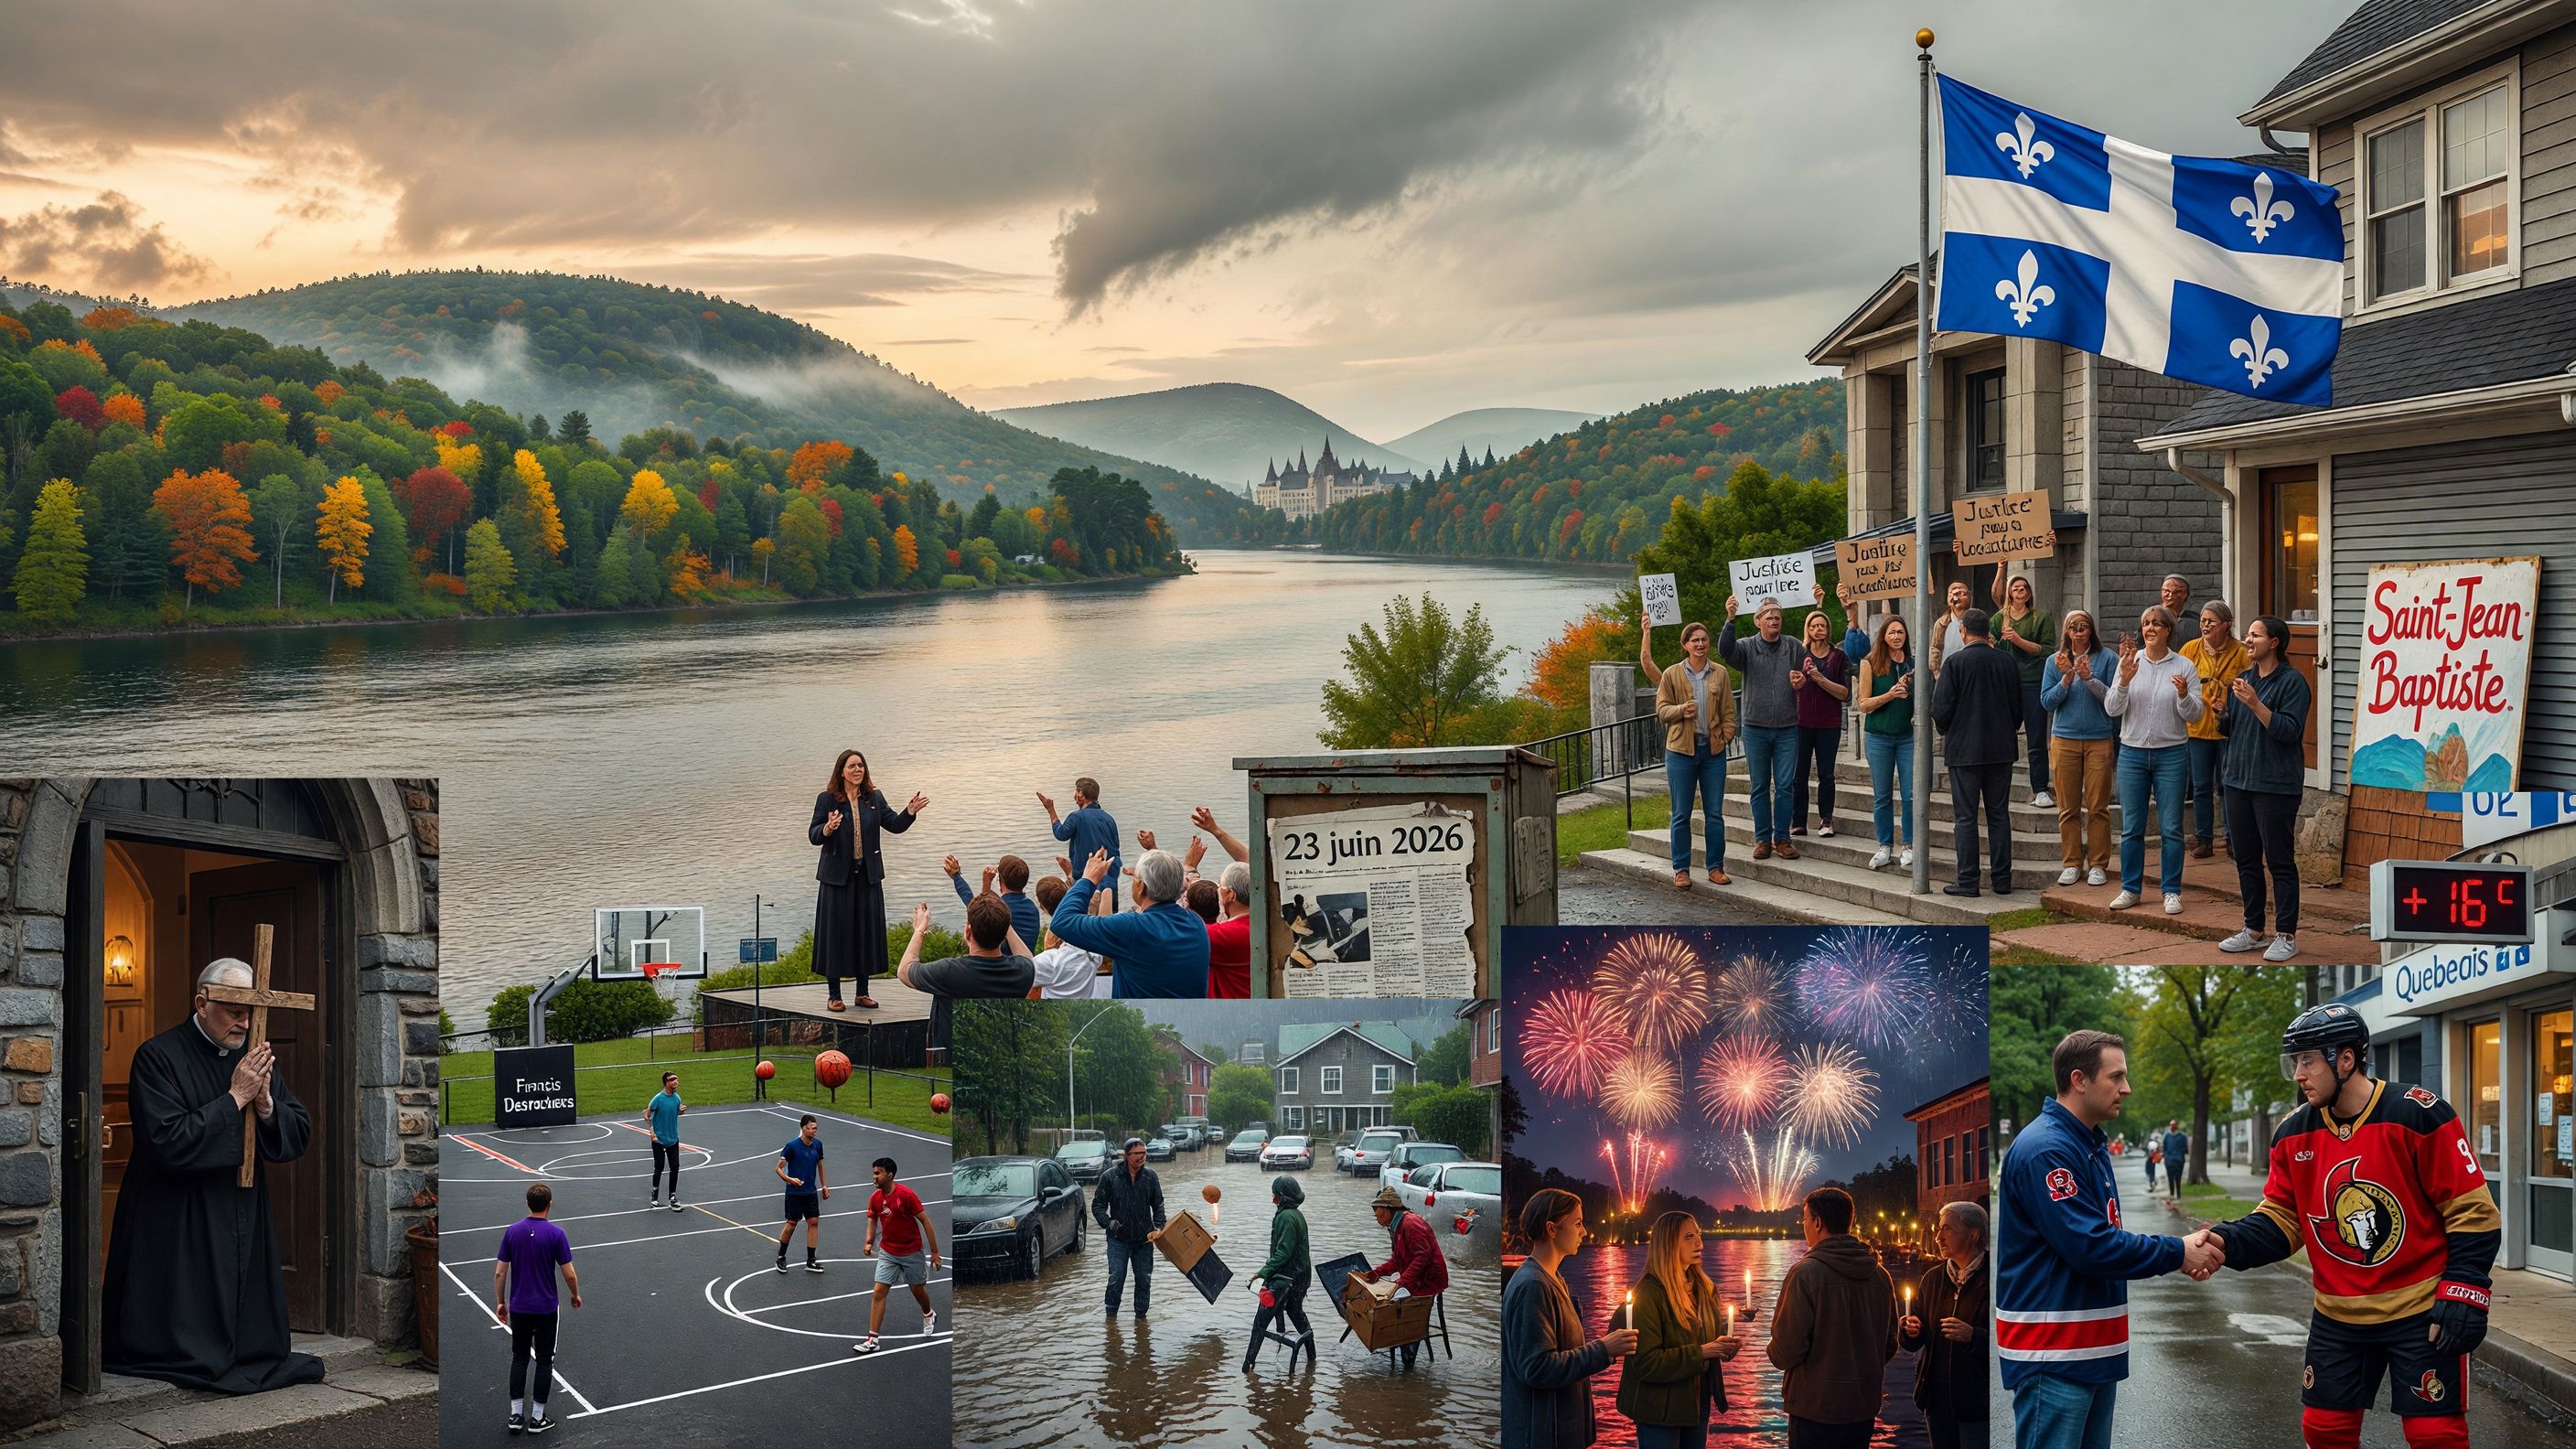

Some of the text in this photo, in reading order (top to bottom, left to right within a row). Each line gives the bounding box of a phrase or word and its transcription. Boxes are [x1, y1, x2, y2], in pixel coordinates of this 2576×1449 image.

[1283, 822, 1465, 867] 23 juin 2026
